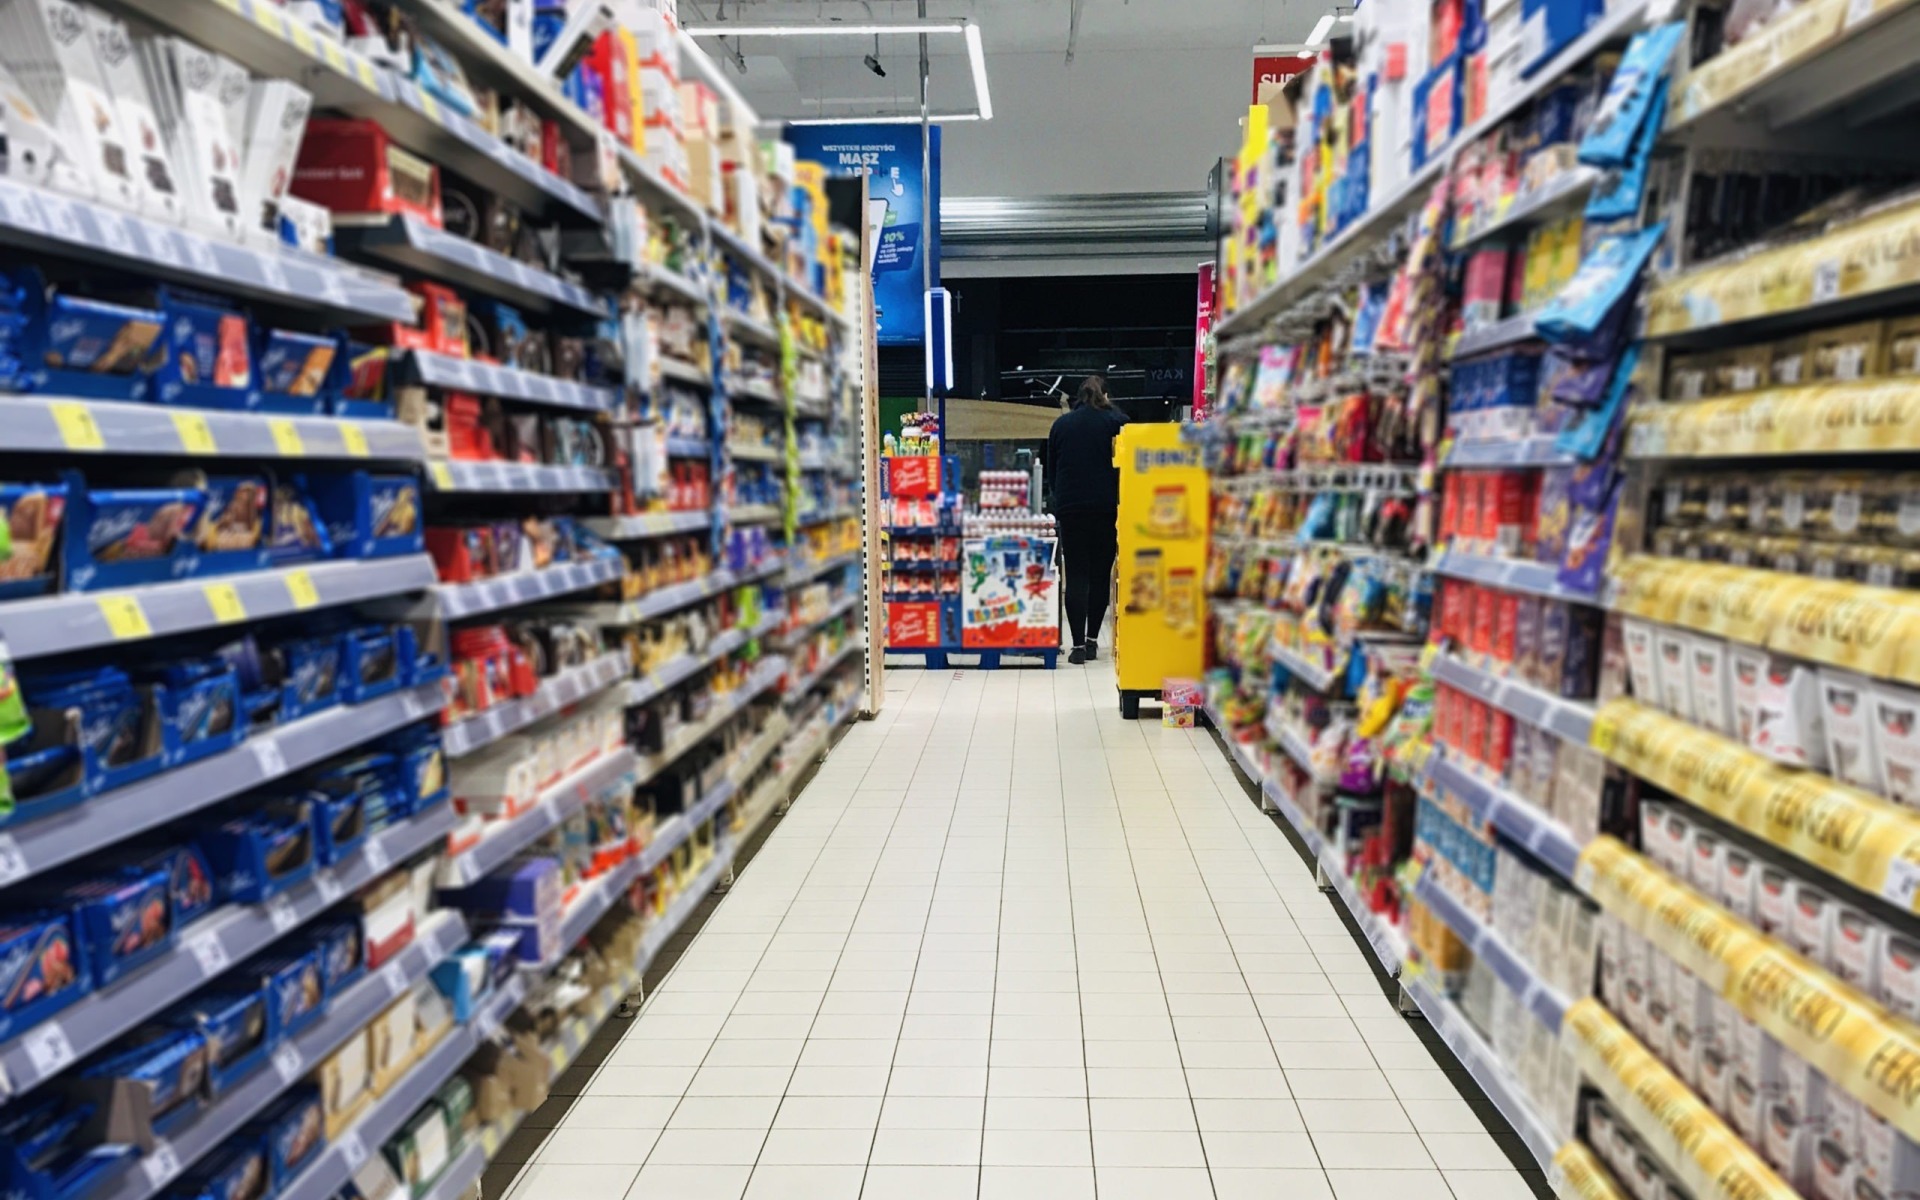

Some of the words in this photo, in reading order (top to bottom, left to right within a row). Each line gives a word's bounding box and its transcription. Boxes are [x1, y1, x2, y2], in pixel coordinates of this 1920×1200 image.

[839, 152, 880, 165] MASZ
[884, 231, 905, 243] 10%
[927, 458, 938, 490] MINI
[926, 610, 937, 642] MINI
